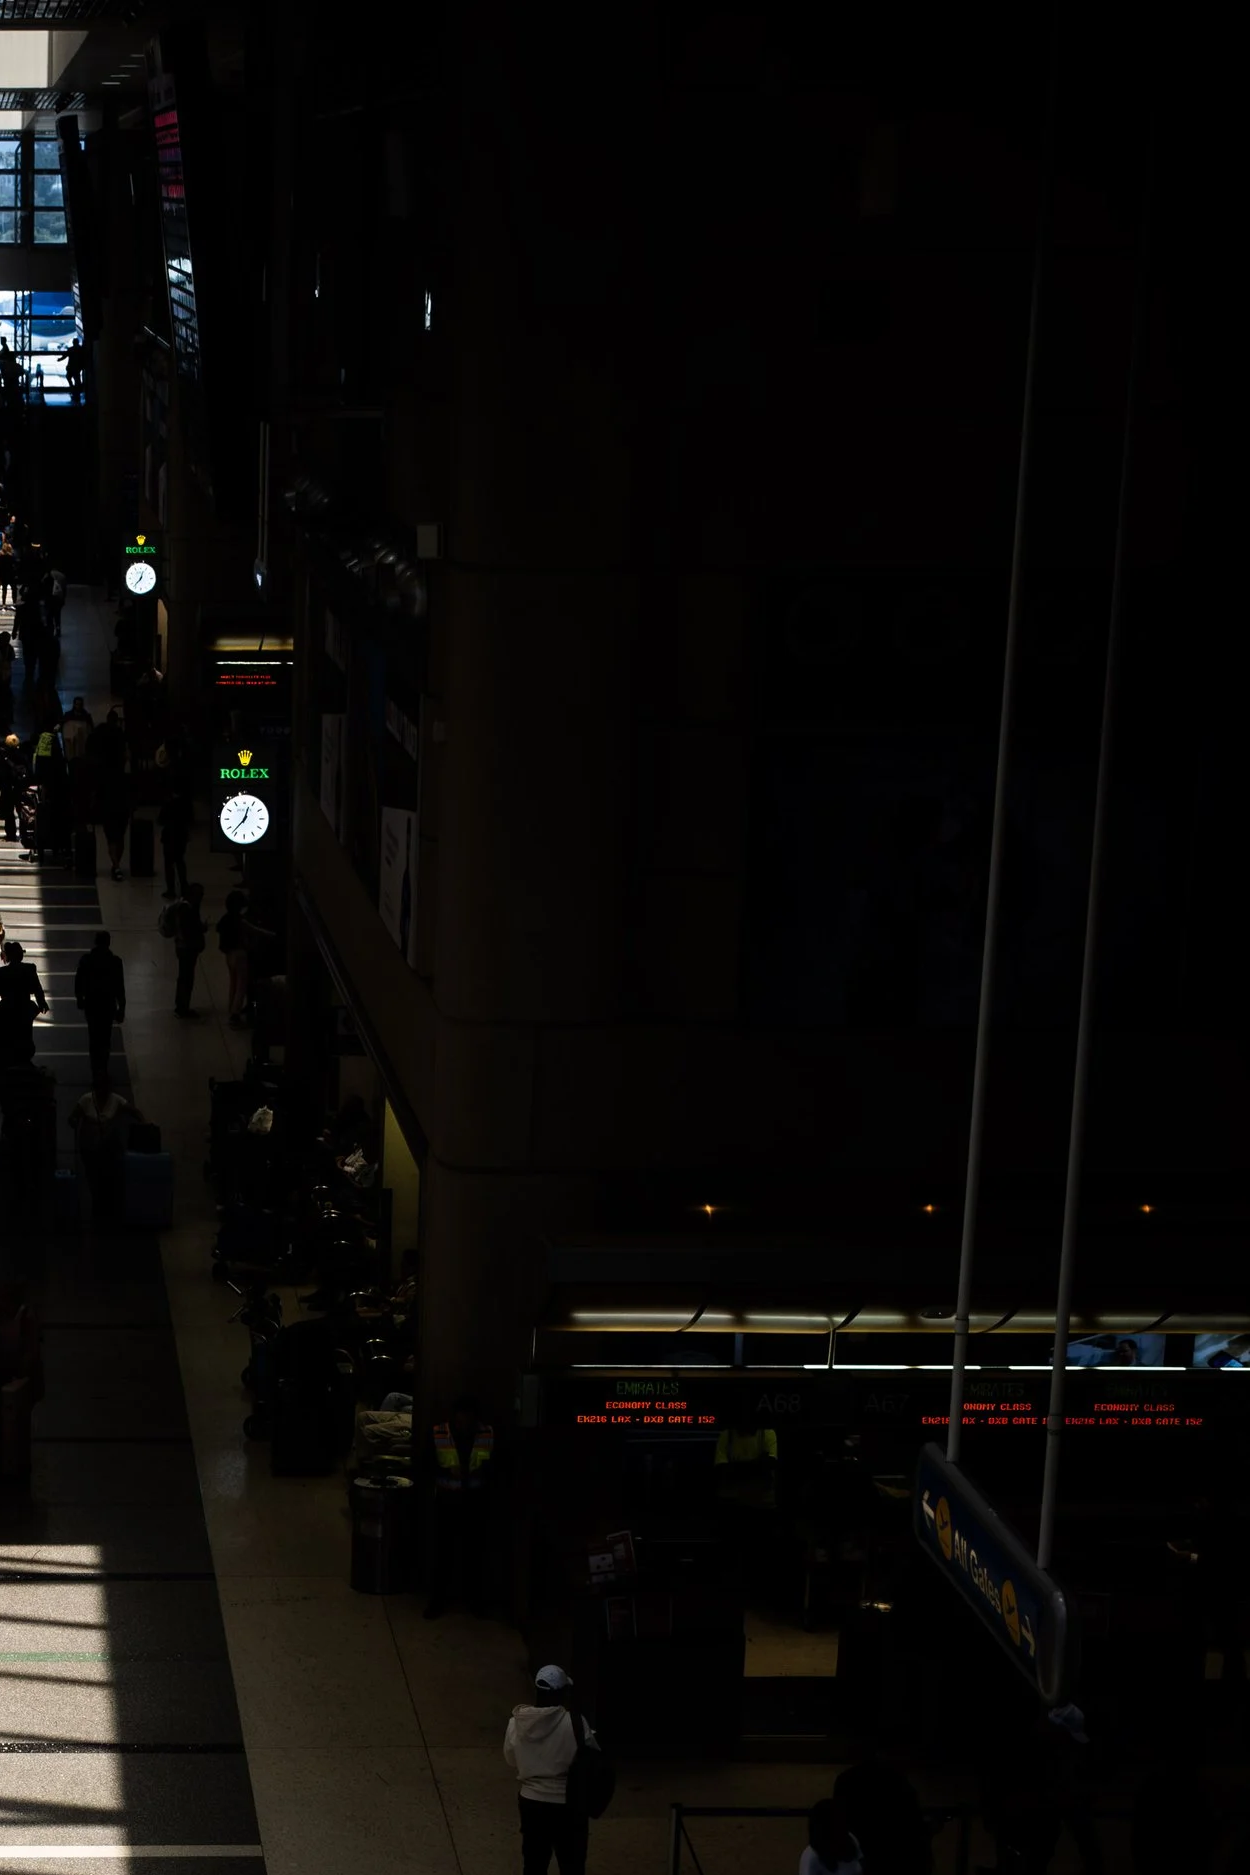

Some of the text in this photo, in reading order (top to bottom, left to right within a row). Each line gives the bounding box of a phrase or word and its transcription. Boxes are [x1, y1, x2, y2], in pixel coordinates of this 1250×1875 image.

[125, 546, 156, 554] ROLEX
[220, 768, 269, 779] ROLEX
[616, 1381, 679, 1395] EMIRATES
[605, 1401, 687, 1410] ECONOMY CLASS
[963, 1402, 1032, 1411] ONOMY CLASS
[1093, 1403, 1175, 1412] ECONOMY CLASS
[577, 1415, 607, 1424] EK216
[611, 1415, 631, 1424] LAX
[643, 1415, 664, 1424] DXB
[668, 1415, 694, 1424] GATE
[698, 1415, 715, 1424] 152
[962, 1416, 976, 1425] AX
[988, 1416, 1008, 1425] DXB
[1012, 1416, 1038, 1425] GATE
[1065, 1417, 1095, 1426] EK216
[1099, 1417, 1119, 1426] LAX
[1131, 1417, 1152, 1426] DXB
[1155, 1417, 1181, 1426] GATE
[1185, 1417, 1203, 1426] 152
[954, 1529, 1002, 1614] All Gates
